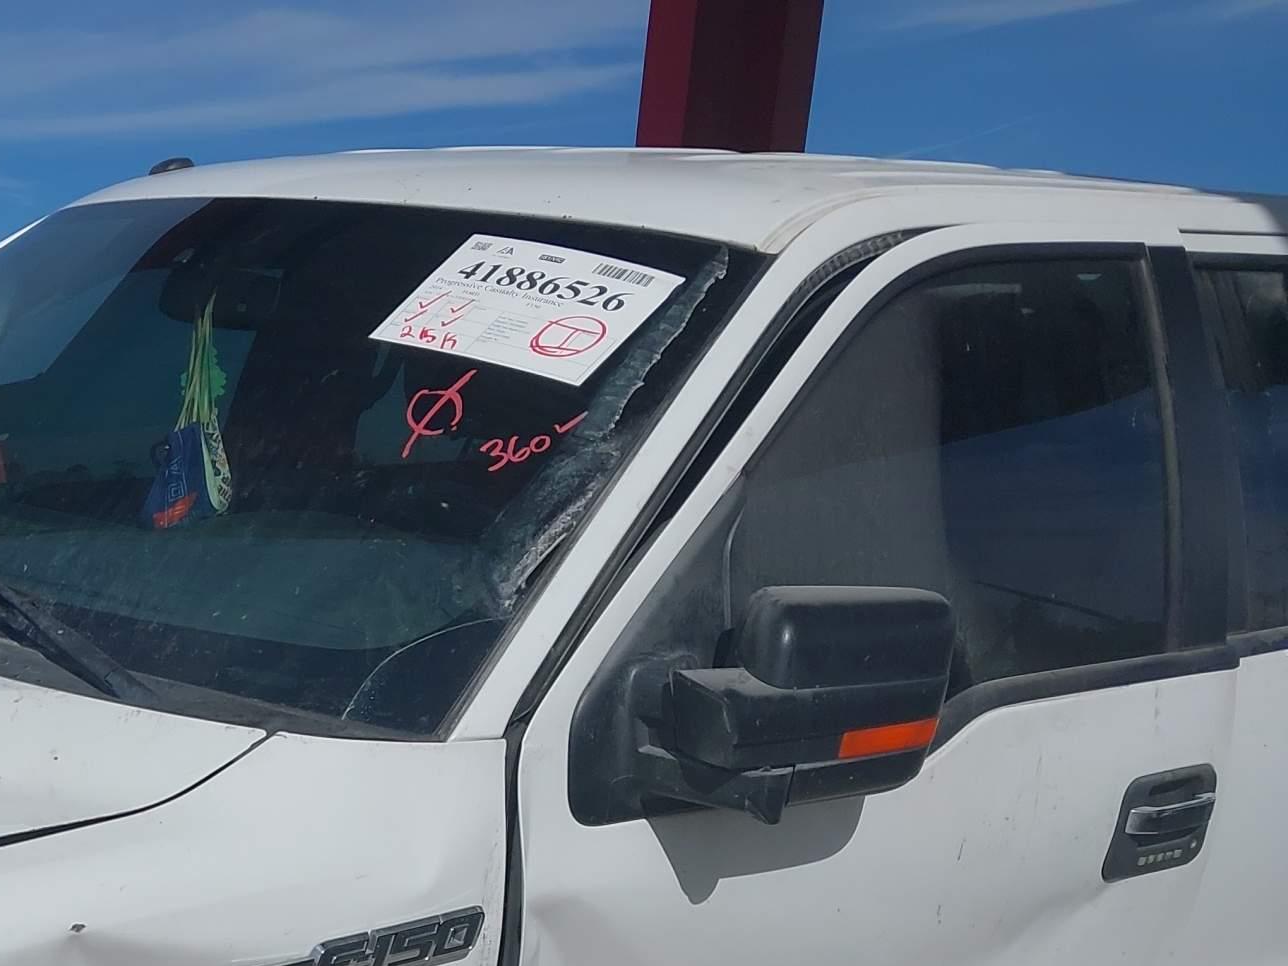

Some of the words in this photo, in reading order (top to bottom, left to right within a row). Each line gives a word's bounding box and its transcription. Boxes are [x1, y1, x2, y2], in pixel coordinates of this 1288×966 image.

[435, 276, 485, 292] Progressive
[484, 284, 521, 300] Casualty
[522, 293, 564, 309] Insurance
[457, 260, 634, 313] 41886526
[479, 435, 552, 472] 360
